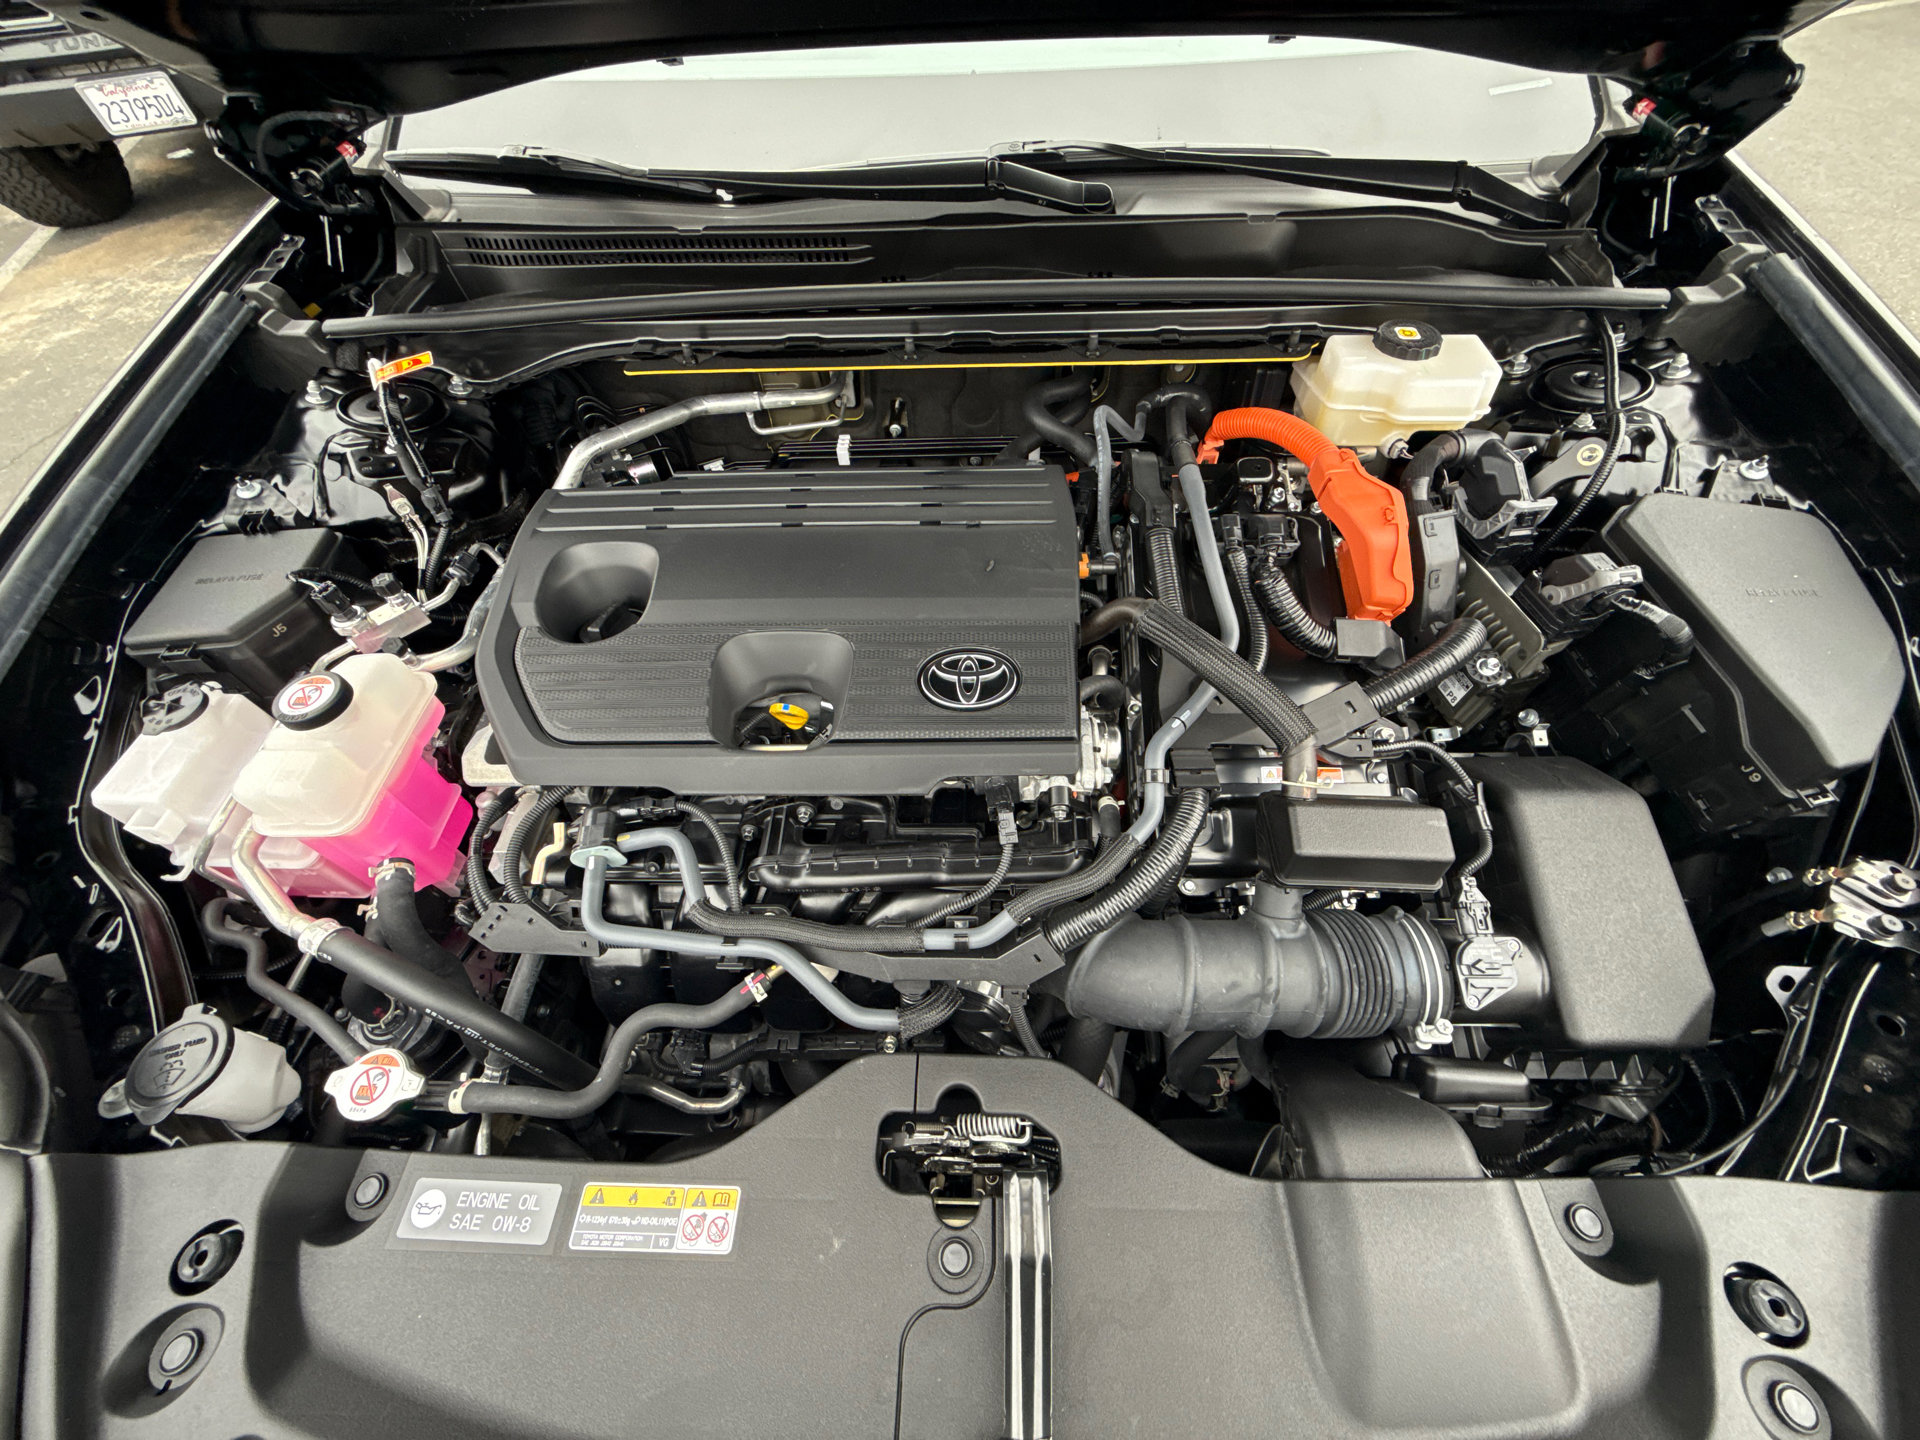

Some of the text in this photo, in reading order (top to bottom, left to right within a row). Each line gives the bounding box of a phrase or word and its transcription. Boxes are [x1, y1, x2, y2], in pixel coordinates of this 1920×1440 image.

[100, 82, 158, 97] California
[98, 94, 184, 125] 23795D4
[272, 623, 287, 638] J5
[1446, 690, 1458, 704] P8
[1740, 764, 1762, 782] J9
[164, 1049, 186, 1060] ONLY
[456, 1191, 541, 1211] ENGINE OIL
[449, 1213, 532, 1233] SAE 0W-8
[659, 1237, 670, 1247] VG
